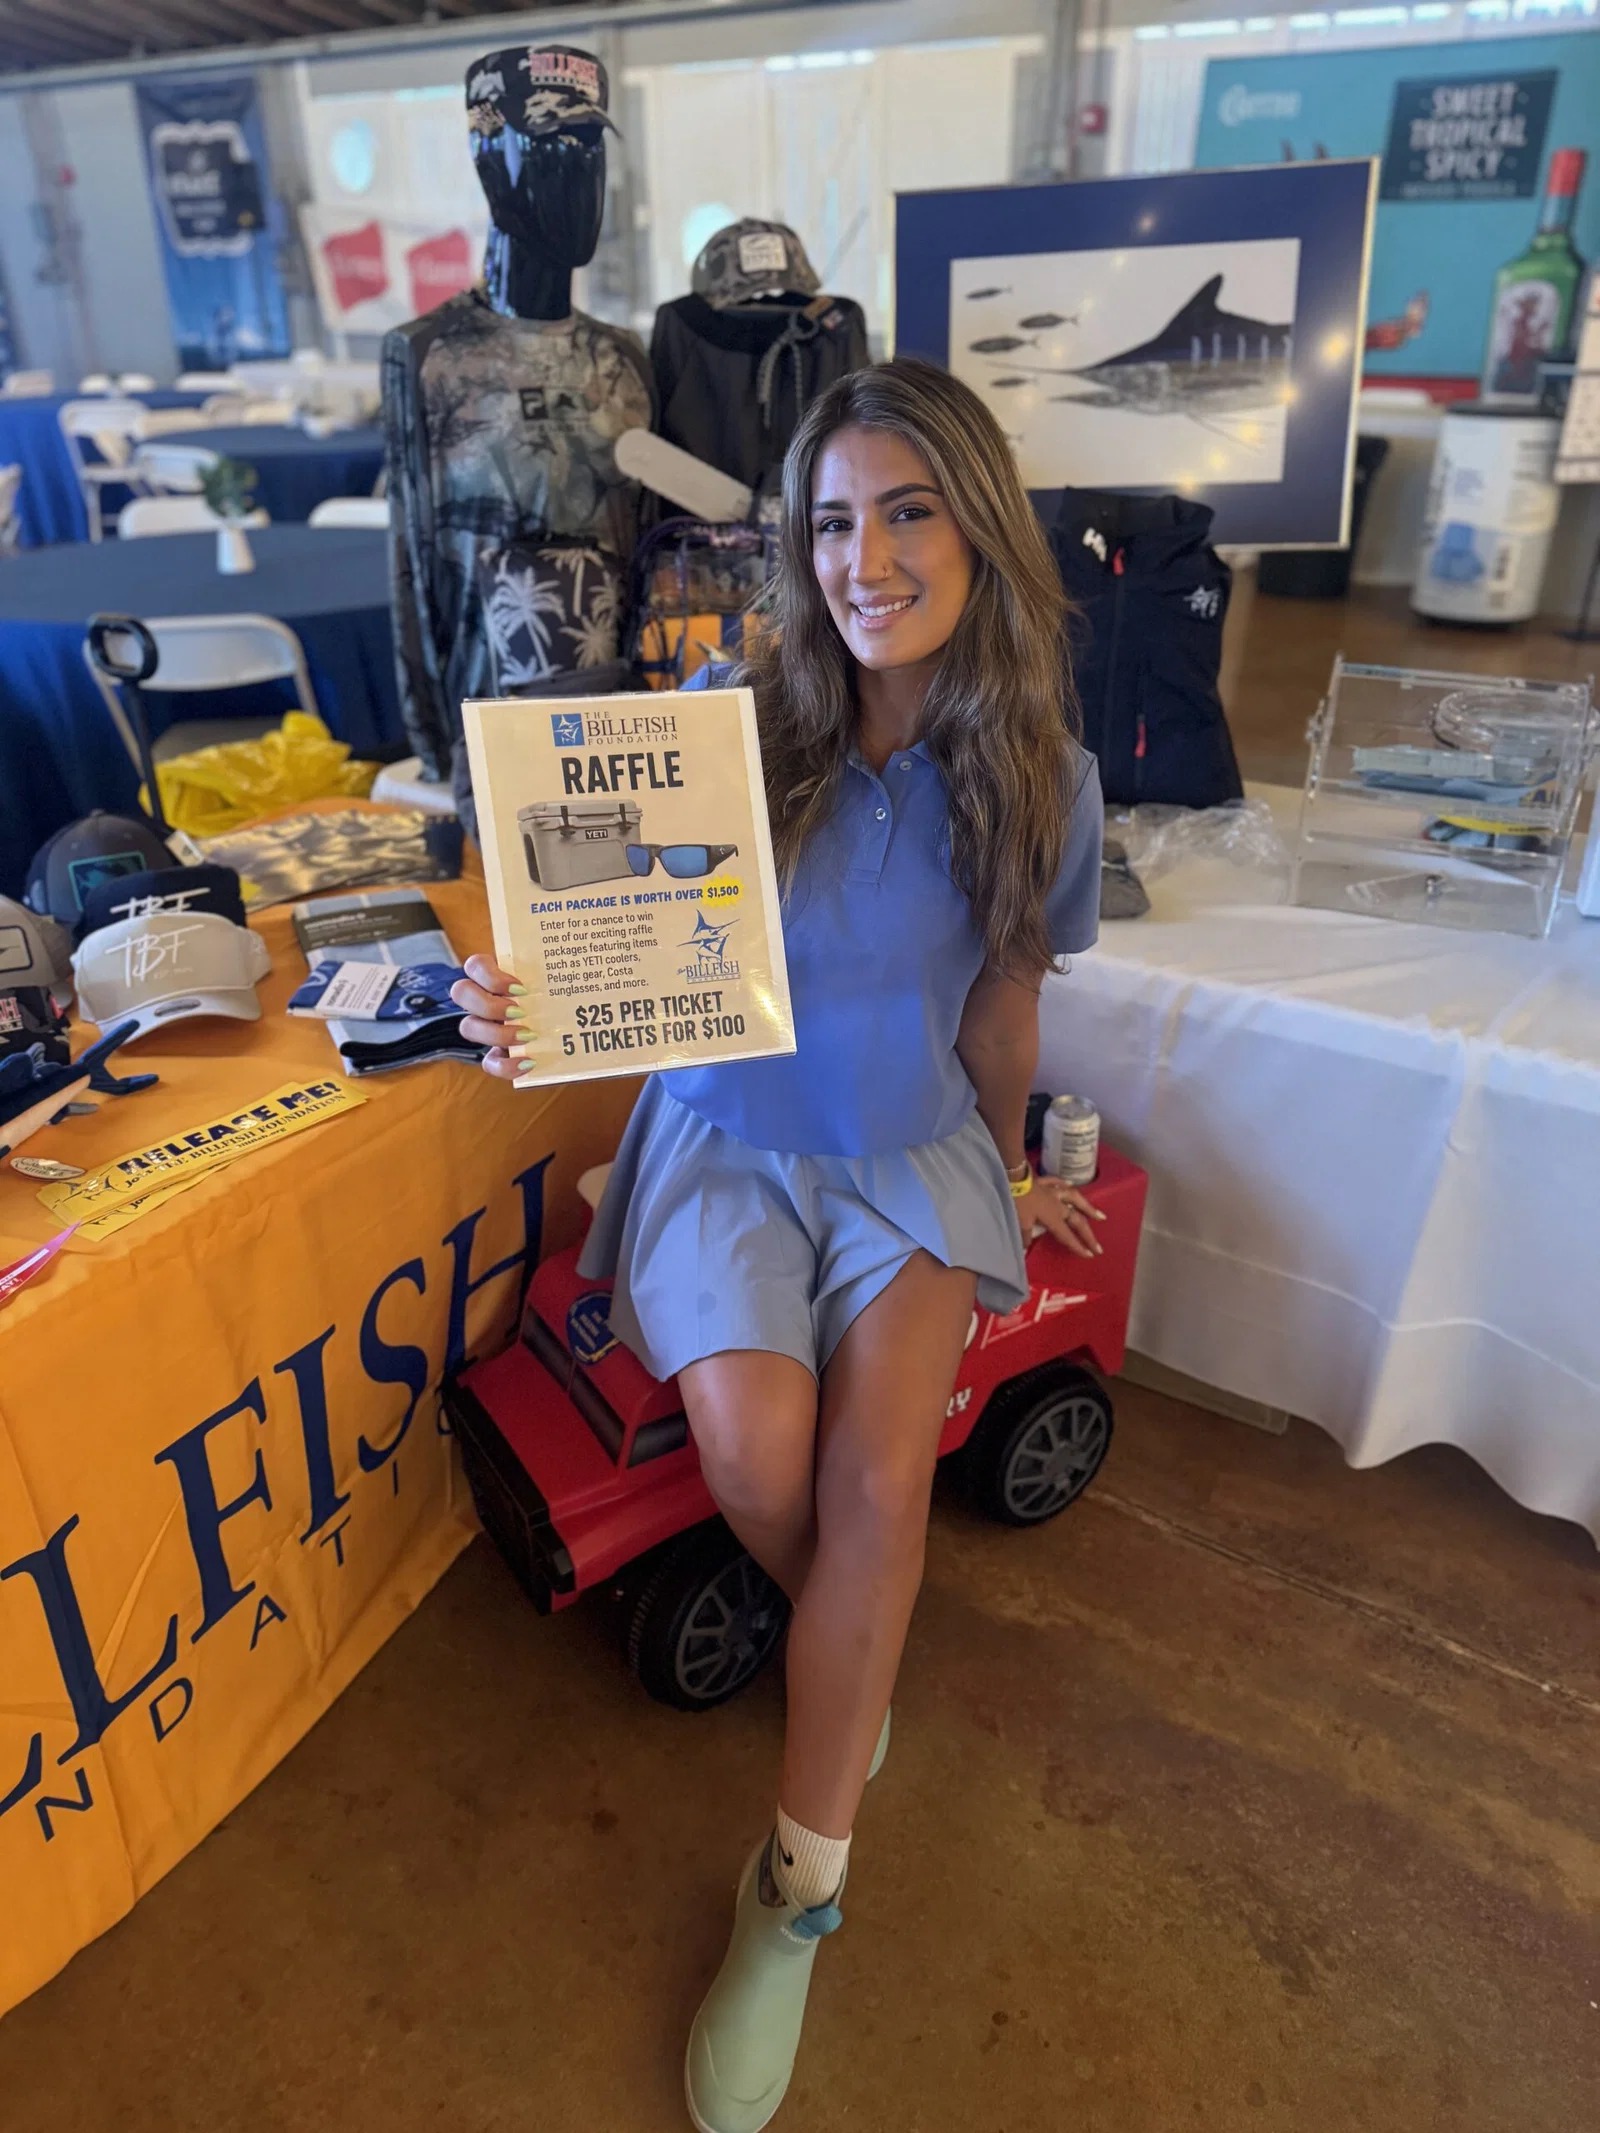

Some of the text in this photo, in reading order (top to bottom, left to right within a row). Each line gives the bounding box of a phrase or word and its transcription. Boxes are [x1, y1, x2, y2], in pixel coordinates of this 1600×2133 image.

[584, 711, 610, 720] THE
[587, 716, 677, 737] BILLFISH
[587, 733, 678, 746] FOUNDATION
[561, 750, 684, 795] RAFFLE
[586, 830, 607, 839] YETI
[531, 885, 739, 914] EACH PACKAGE IS WORTH OVER $1,500
[540, 911, 654, 931] Enter for a chance to win
[542, 925, 653, 944] one of our exciting raffle
[544, 937, 658, 959] packages featuring items
[545, 951, 641, 971] such as YETI coolers,
[686, 960, 740, 977] BILLFISH
[547, 966, 634, 984] Pelagic gear, Costa
[549, 977, 649, 997] sunglasses, and more.
[575, 990, 723, 1029] $25 PER TICKET
[562, 1014, 745, 1056] 5 TICKETS FOR $100
[116, 1082, 341, 1175] RELEASE ME!
[189, 1131, 256, 1159] BILLFISH
[258, 1094, 346, 1133] FOUNDATION
